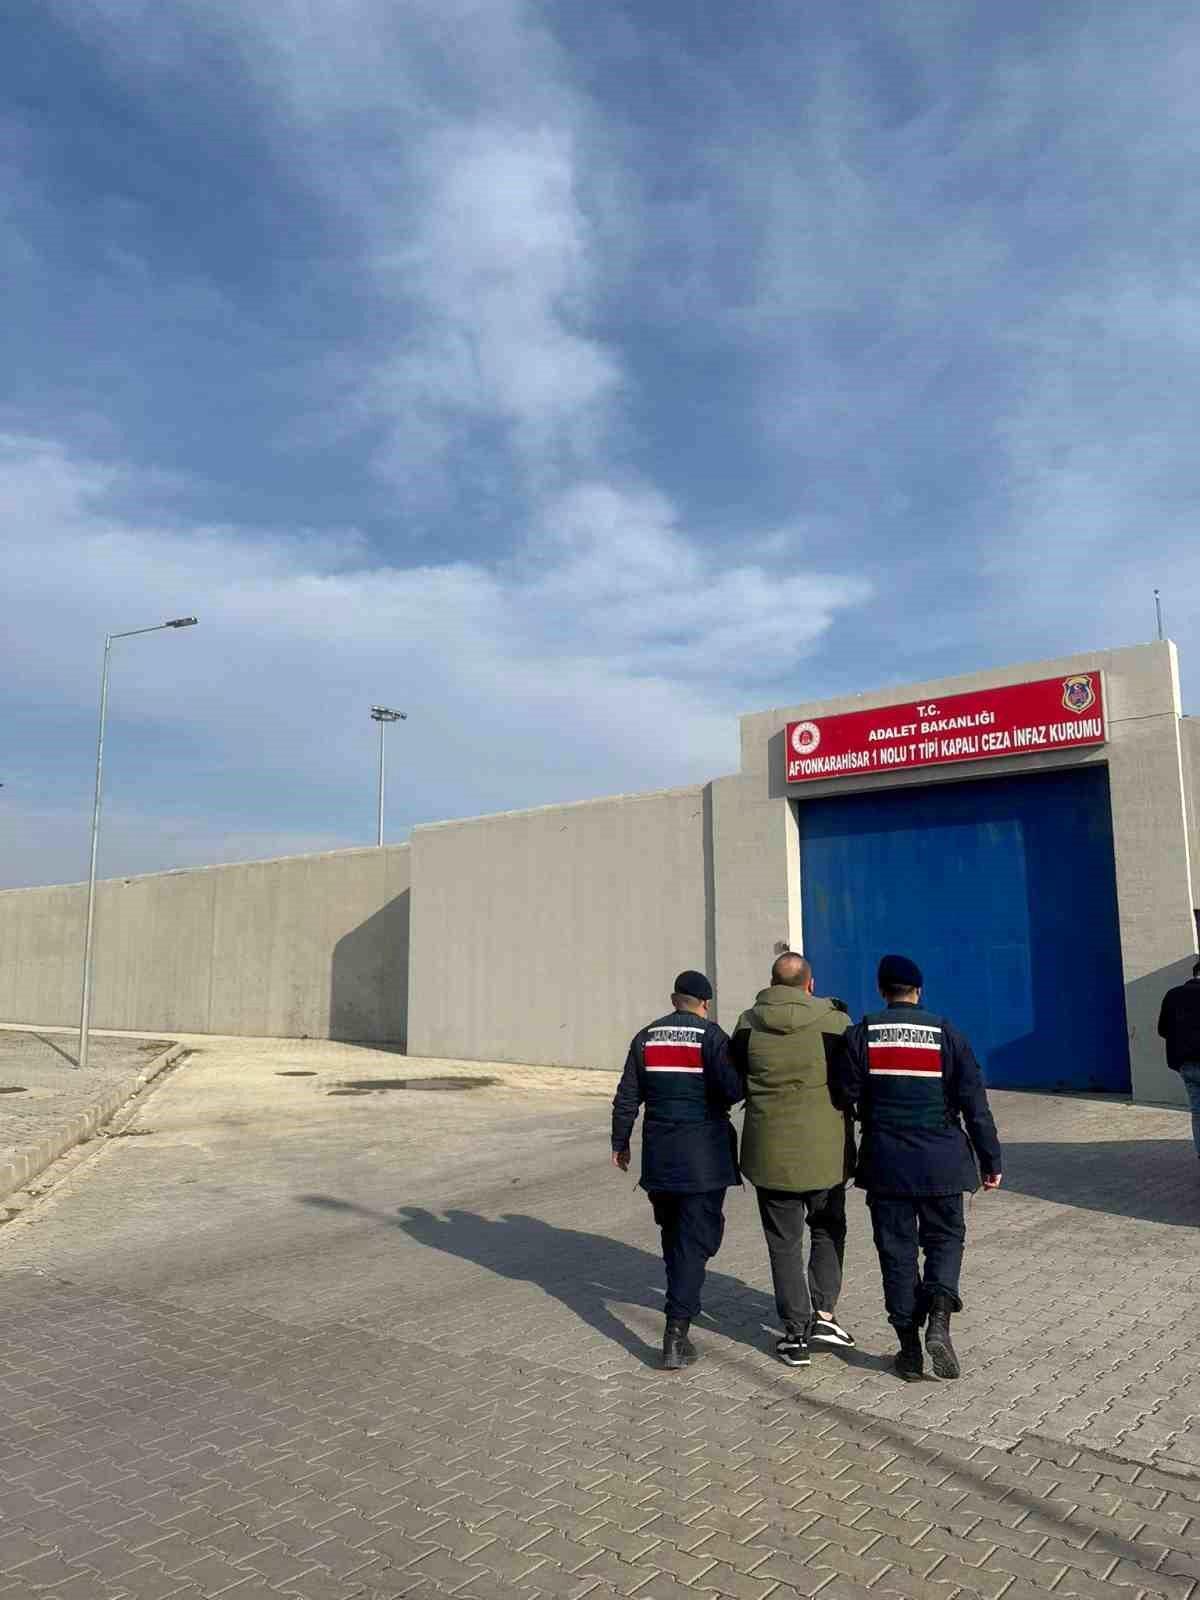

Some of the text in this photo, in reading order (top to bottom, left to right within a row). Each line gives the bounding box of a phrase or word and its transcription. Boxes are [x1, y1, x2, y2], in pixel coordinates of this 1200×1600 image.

[917, 704, 941, 718] T.C.
[868, 711, 995, 741] ADALET BAKANLIĞI
[788, 717, 1102, 777] AFYONKARAHİSAR 1 NOLU T TİPİ KAPALI CEZA İNFAZ KURUMU
[875, 1028, 936, 1044] JANDARMA
